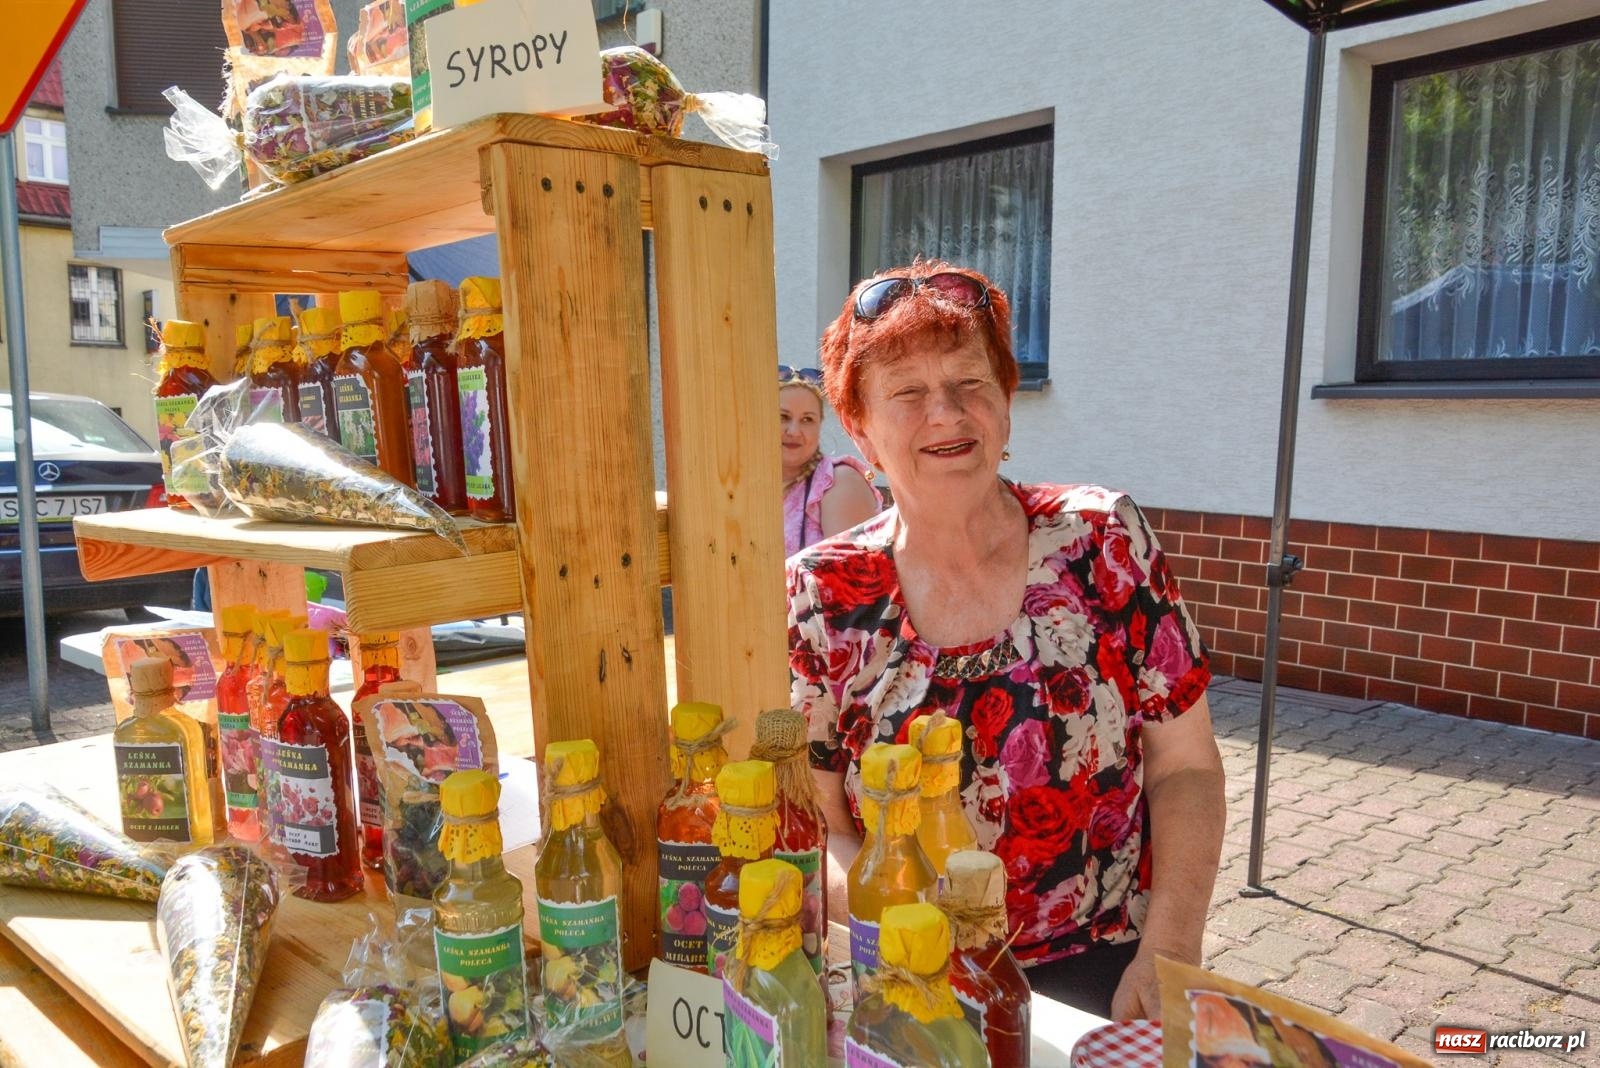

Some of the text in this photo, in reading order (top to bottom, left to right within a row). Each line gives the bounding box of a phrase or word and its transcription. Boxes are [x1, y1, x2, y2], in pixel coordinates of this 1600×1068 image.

[447, 30, 567, 88] SYROPY
[3, 500, 47, 518] SC
[123, 761, 172, 769] SZAMANKA
[686, 854, 722, 863] SZAMANK
[562, 915, 605, 927] SZAMANKA
[554, 928, 585, 937] POLECA
[468, 942, 511, 956] SZAMANKA
[674, 939, 704, 949] OCET
[460, 957, 492, 967] POLECA
[665, 951, 707, 963] MIRABE
